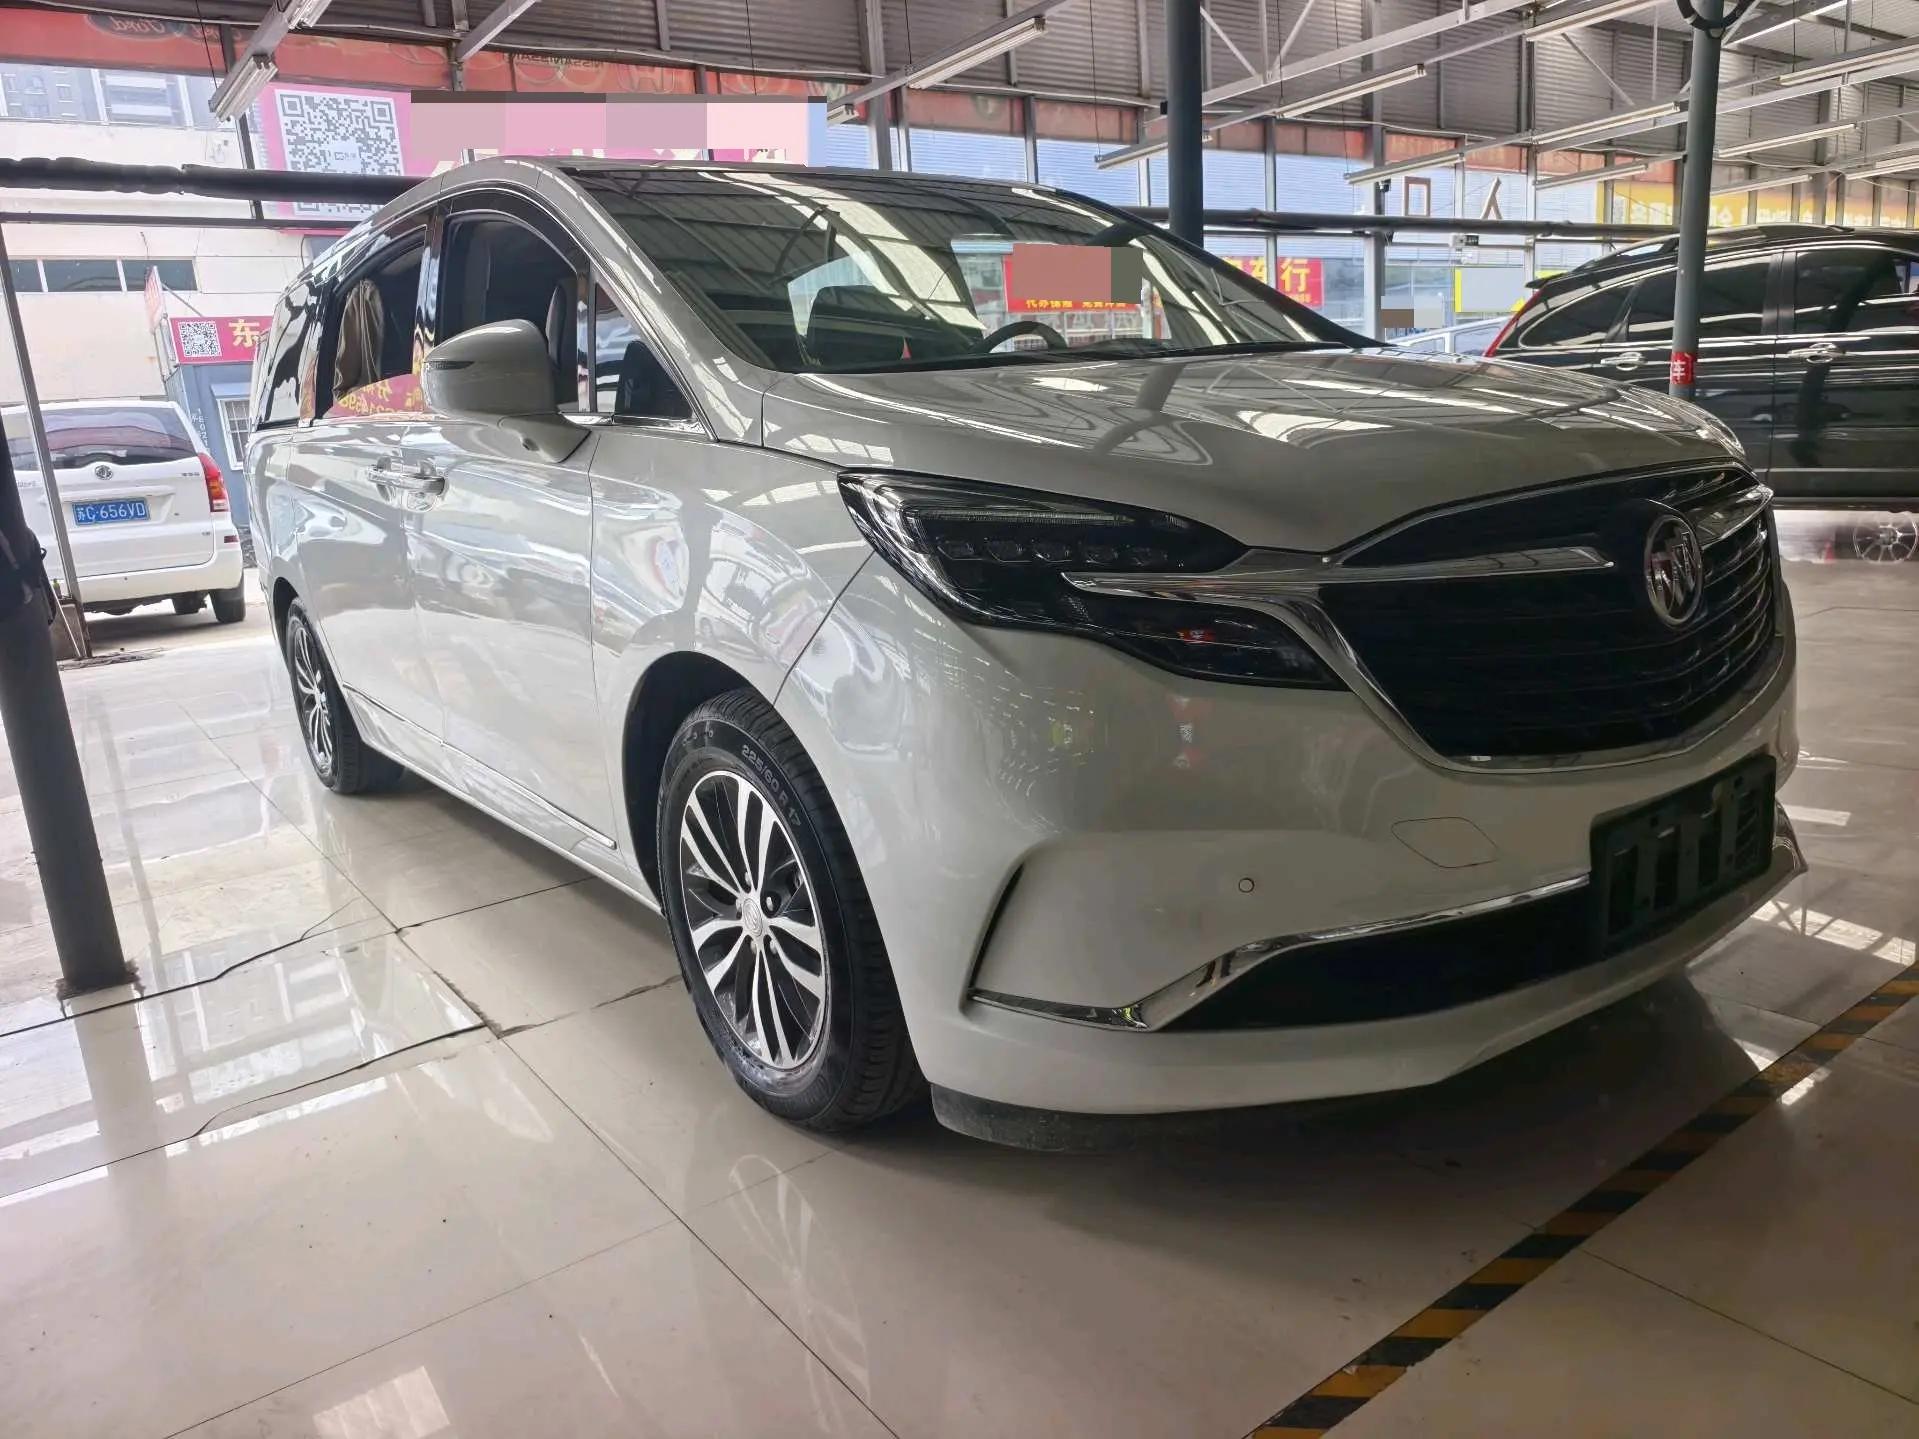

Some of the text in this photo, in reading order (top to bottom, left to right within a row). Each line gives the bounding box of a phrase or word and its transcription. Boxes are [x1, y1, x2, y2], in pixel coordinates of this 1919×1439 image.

[228, 319, 259, 348] 东
[742, 744, 802, 827] 225/60 R 17
